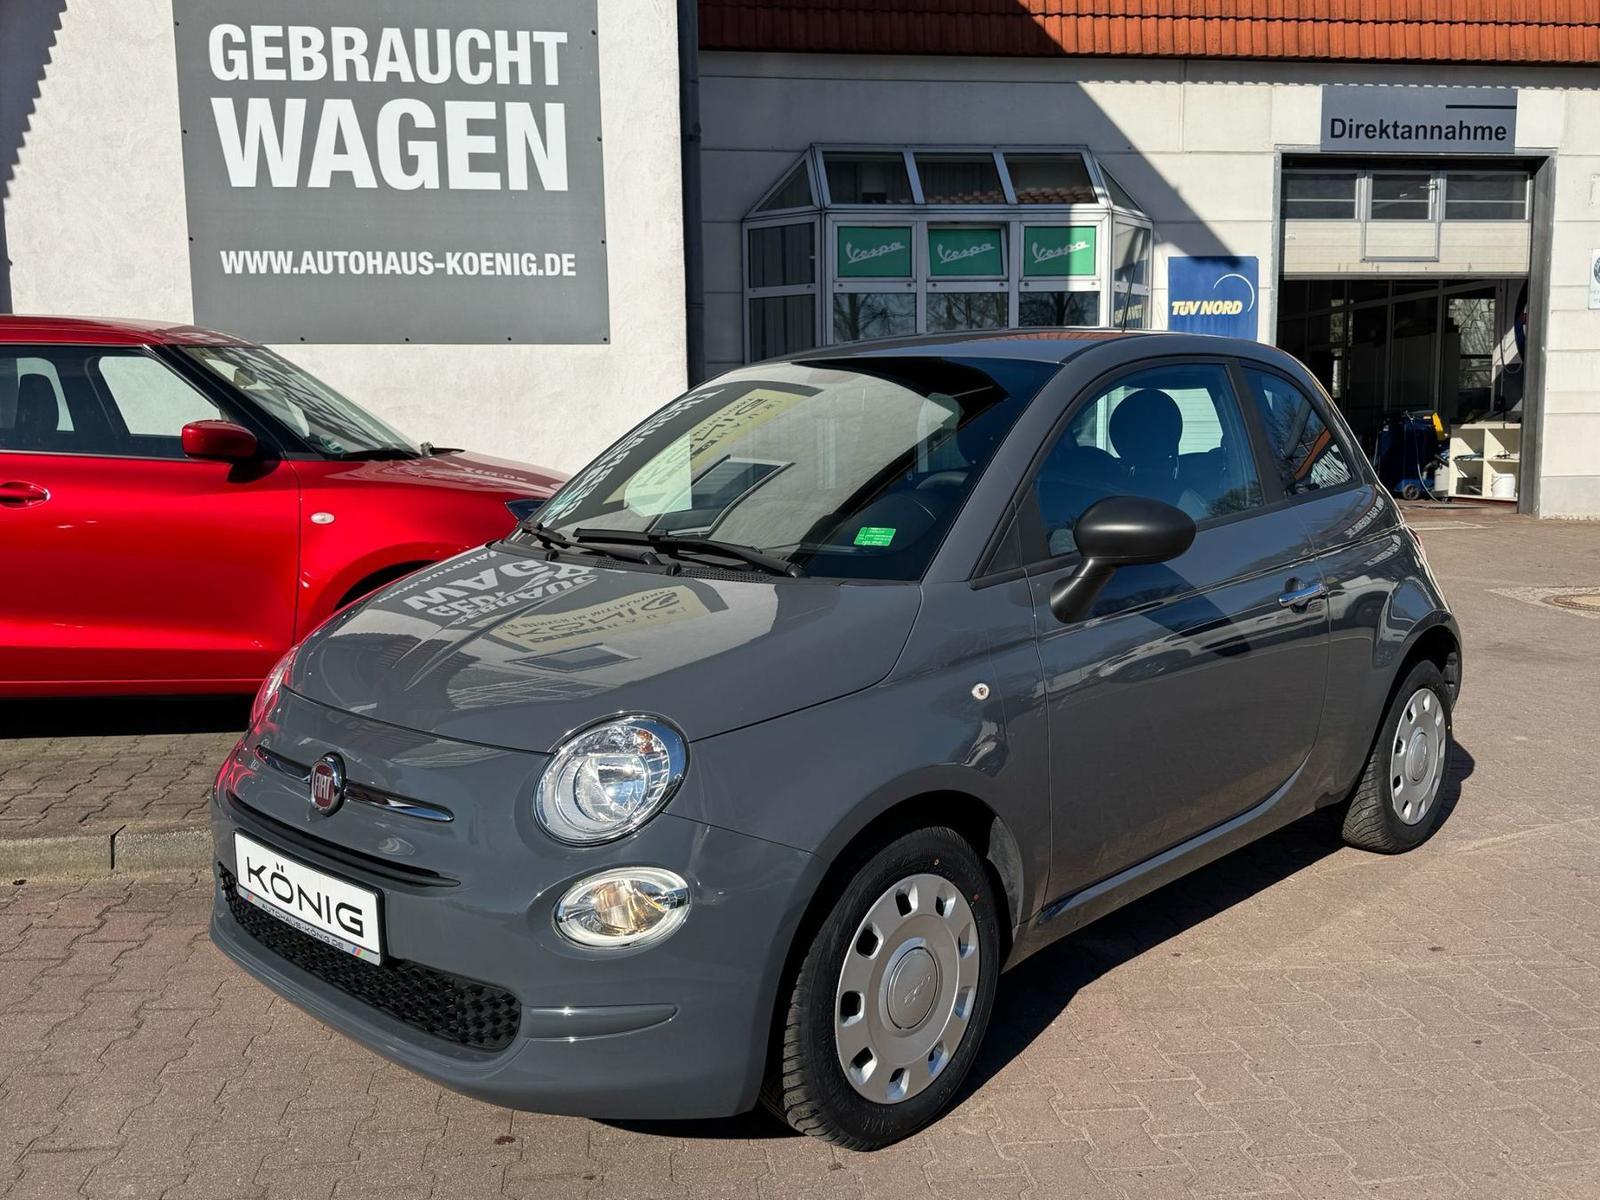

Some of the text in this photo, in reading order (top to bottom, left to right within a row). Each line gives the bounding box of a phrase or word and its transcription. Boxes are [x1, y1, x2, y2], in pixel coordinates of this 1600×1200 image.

[208, 23, 568, 86] GEBRAUCHT
[1330, 118, 1507, 141] Direktannahme
[210, 97, 568, 191] WAGEN
[220, 250, 576, 277] WWW.AUTOHAUS-KOENIG.DE
[846, 241, 905, 264] Vespa
[938, 242, 995, 264] Vespa
[1032, 241, 1091, 264] Vespa
[1200, 300, 1243, 315] NORD
[314, 774, 332, 800] FIAT
[246, 856, 365, 938] KÖNIG
